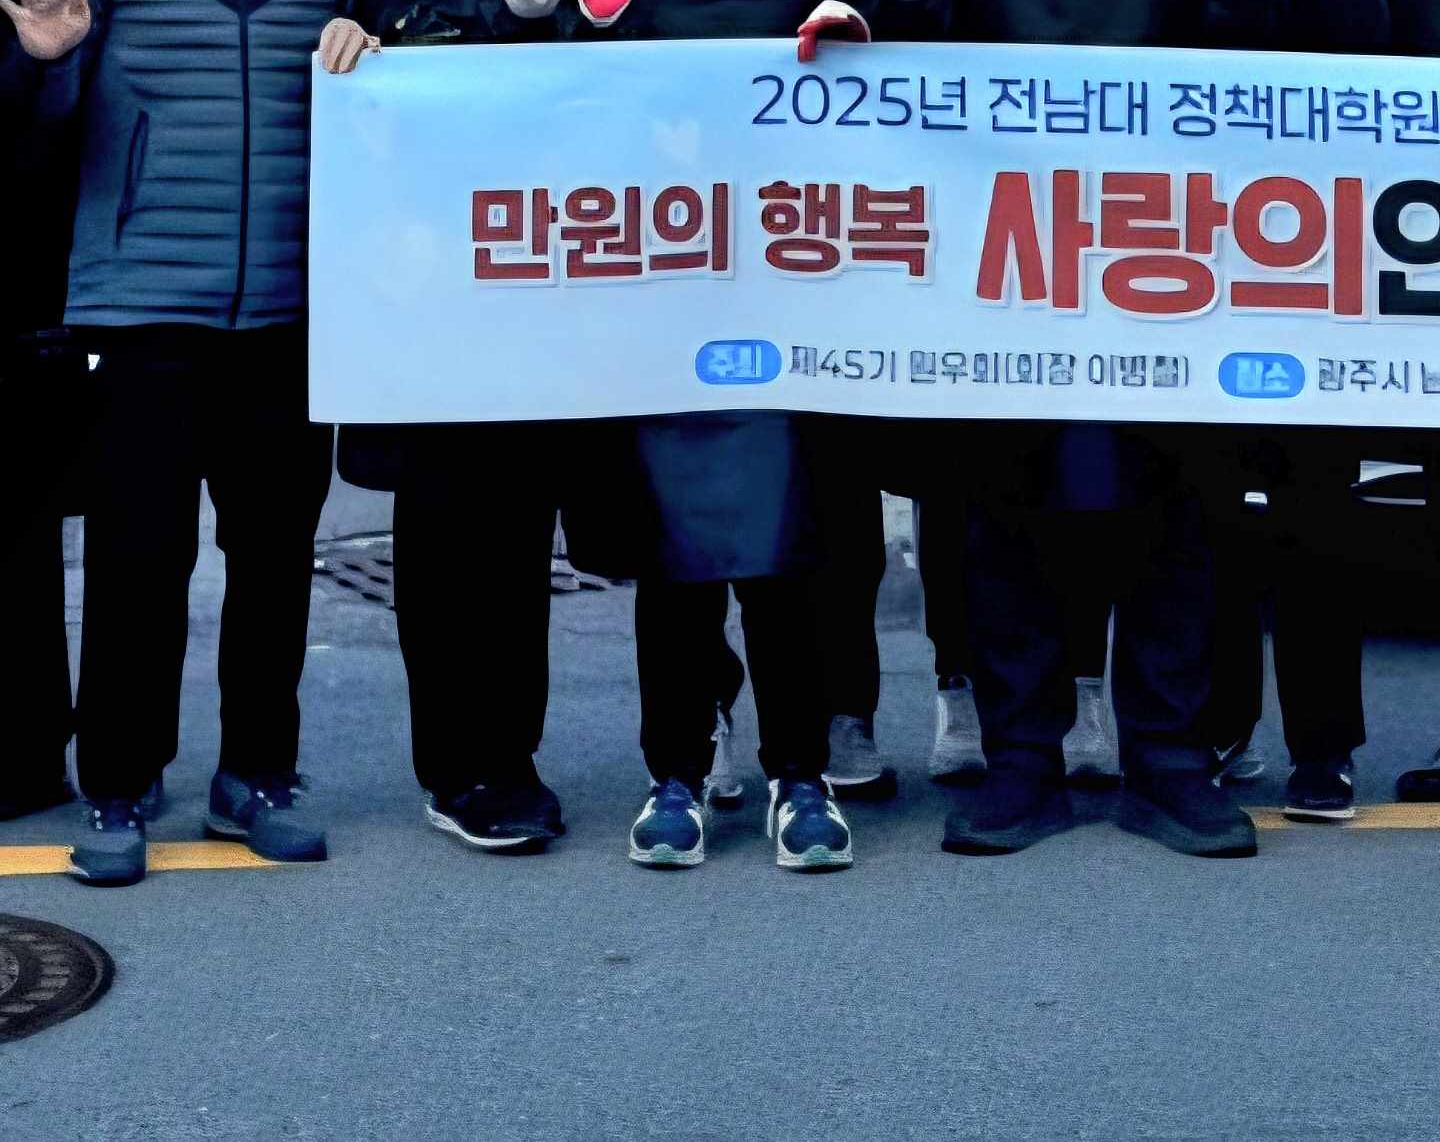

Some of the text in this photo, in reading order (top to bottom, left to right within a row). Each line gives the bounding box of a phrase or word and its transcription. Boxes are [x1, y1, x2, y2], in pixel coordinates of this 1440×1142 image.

[751, 74, 968, 131] 2025년
[988, 77, 1148, 136] 전남대
[471, 182, 729, 280] 만원의
[757, 179, 930, 277] 행복
[788, 345, 896, 383] 제45기
